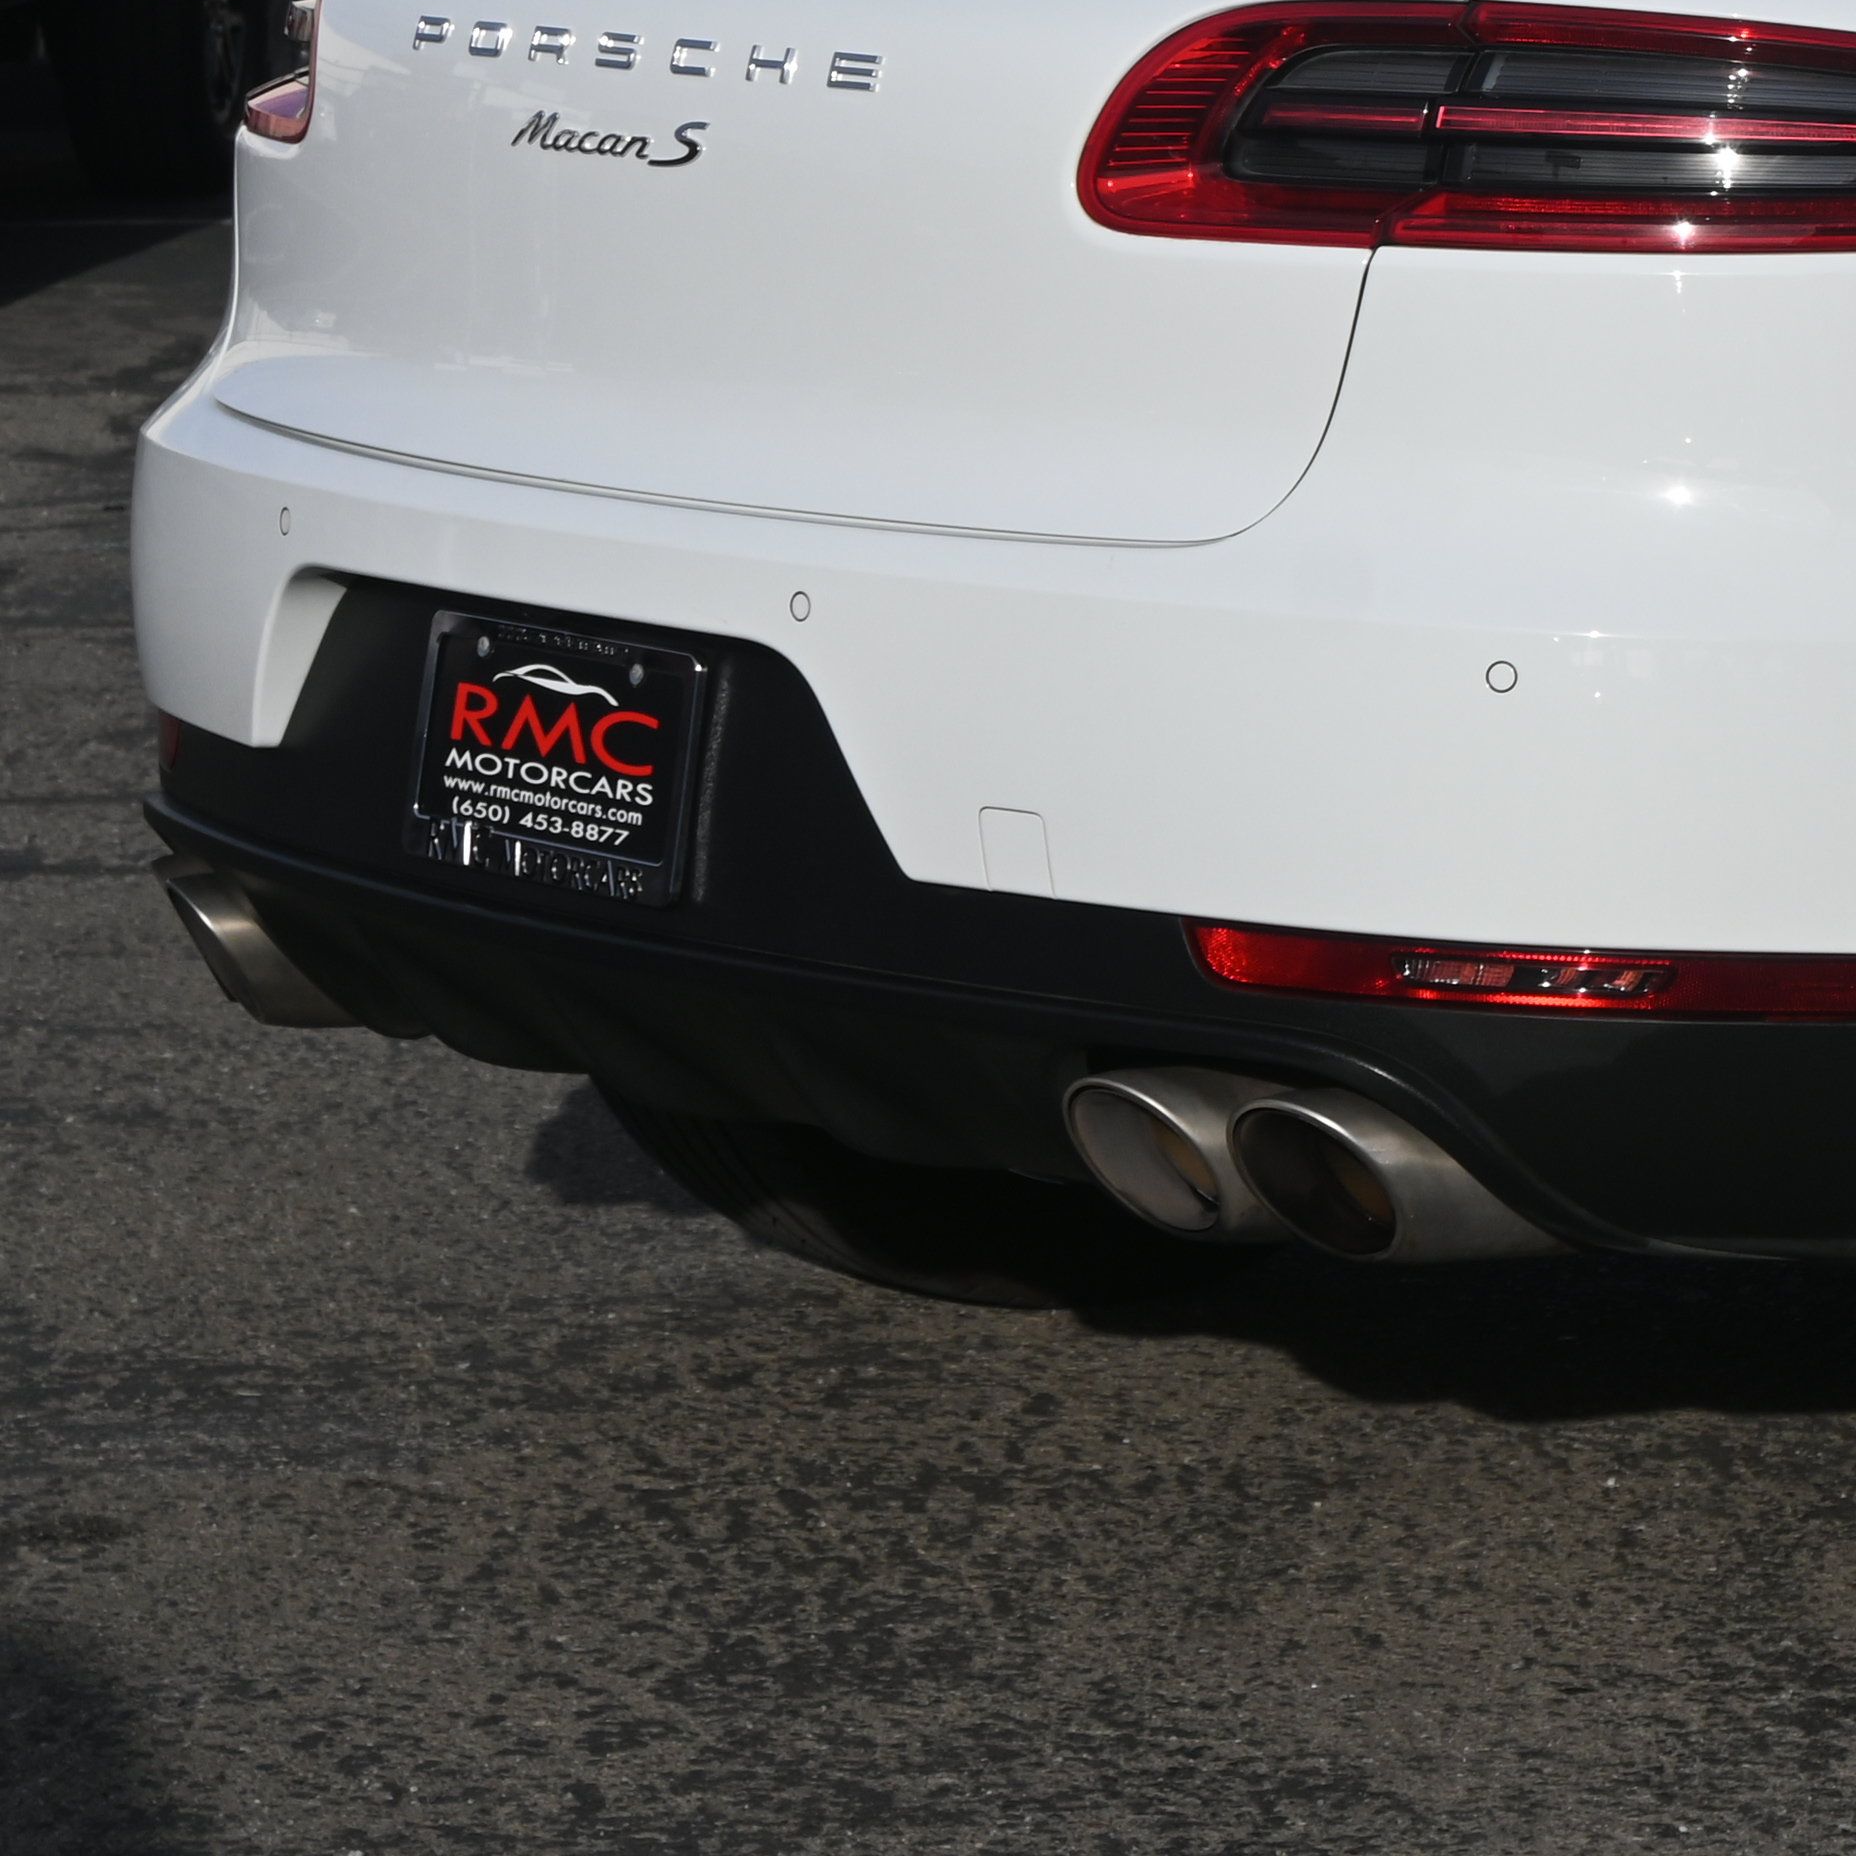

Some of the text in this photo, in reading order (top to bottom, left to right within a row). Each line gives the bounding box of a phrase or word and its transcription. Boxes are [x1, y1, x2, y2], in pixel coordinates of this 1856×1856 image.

[412, 14, 885, 93] PORSCHE
[511, 110, 711, 168] Macan S
[449, 682, 660, 777] RMC
[443, 774, 643, 826] www.rmcmotorcars.com
[444, 747, 654, 806] MOTORCARS
[451, 796, 630, 846] (650) 453-8877
